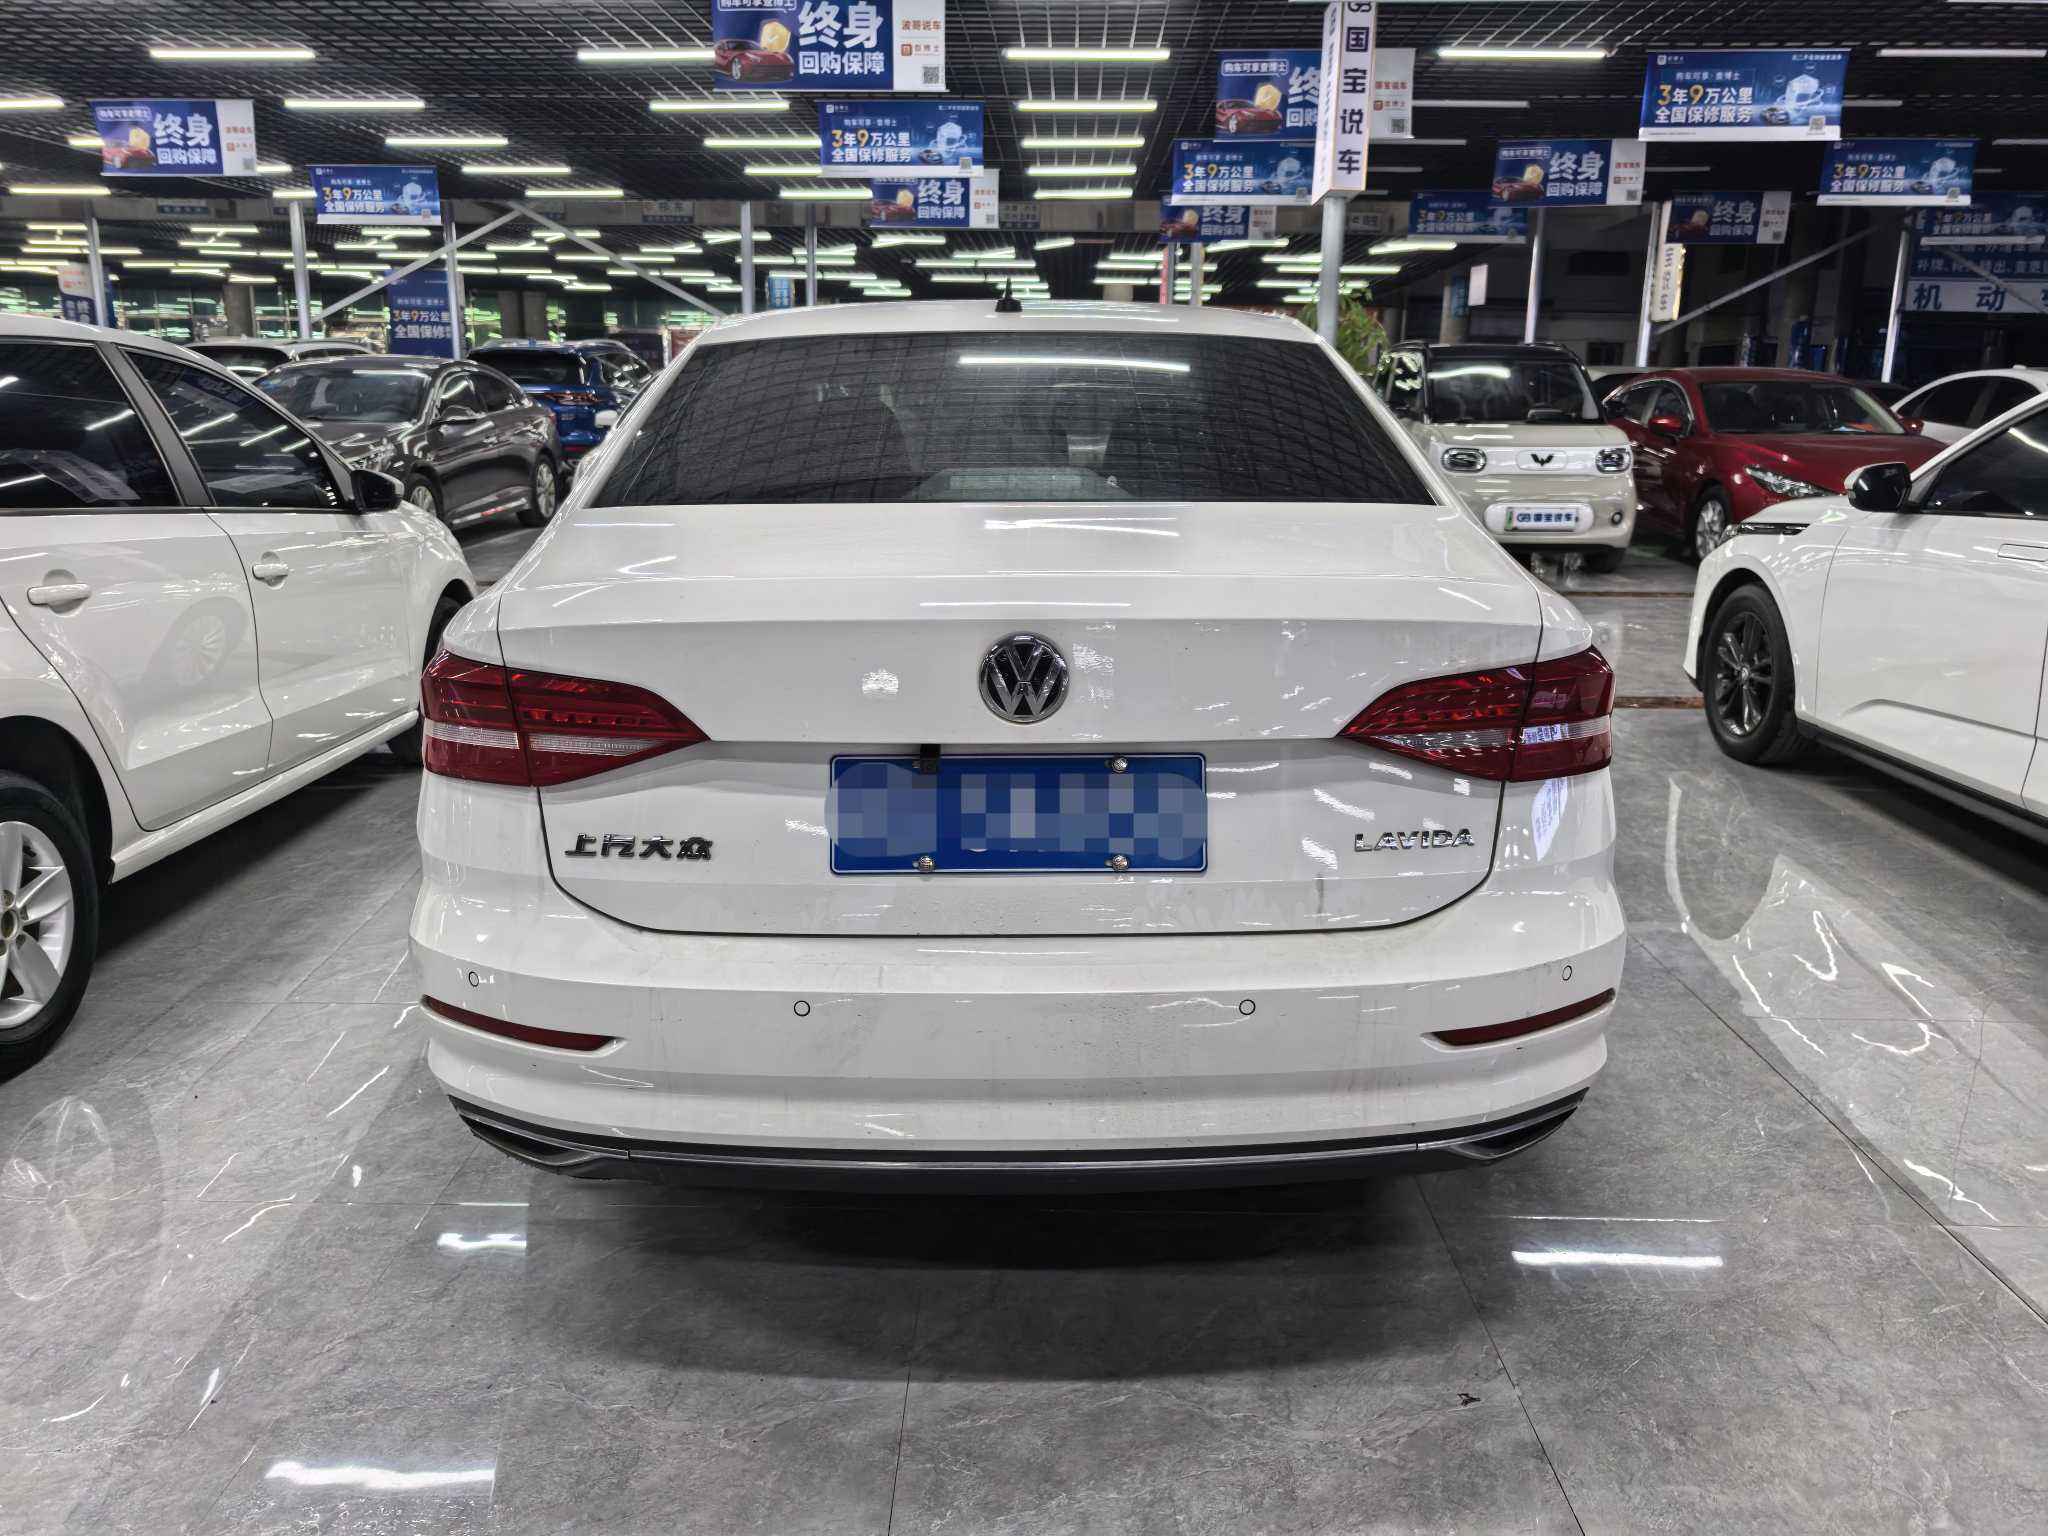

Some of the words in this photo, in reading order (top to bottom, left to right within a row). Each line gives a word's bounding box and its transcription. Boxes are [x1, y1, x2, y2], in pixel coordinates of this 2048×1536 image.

[798, 1, 884, 49] 终身
[799, 51, 885, 75] 回购保障
[1224, 62, 1287, 73] 购车可享查博士
[1337, 26, 1370, 175] 国宝说车
[1658, 84, 1753, 106] 3年9万公里
[1655, 105, 1753, 124] 全国保修服务
[153, 112, 212, 147] 终身
[831, 129, 911, 148] 3年9万公里
[156, 148, 217, 165] 回购保障
[831, 147, 913, 163] 全国保修服务
[1183, 163, 1255, 180] 3年9万公里
[1548, 151, 1604, 181] 终身
[1833, 163, 1907, 180] 3年9万公里
[322, 186, 384, 201] 3年9万公里
[917, 179, 966, 205] 终身
[1182, 179, 1254, 193] 全国保修服务
[1546, 182, 1603, 197] 回购保障
[1830, 179, 1906, 193] 全国保修服务
[917, 205, 966, 220] 回购保障
[1712, 200, 1756, 223] 终身
[565, 832, 713, 861] 上汽大众
[1354, 828, 1475, 852] LAVIDA
